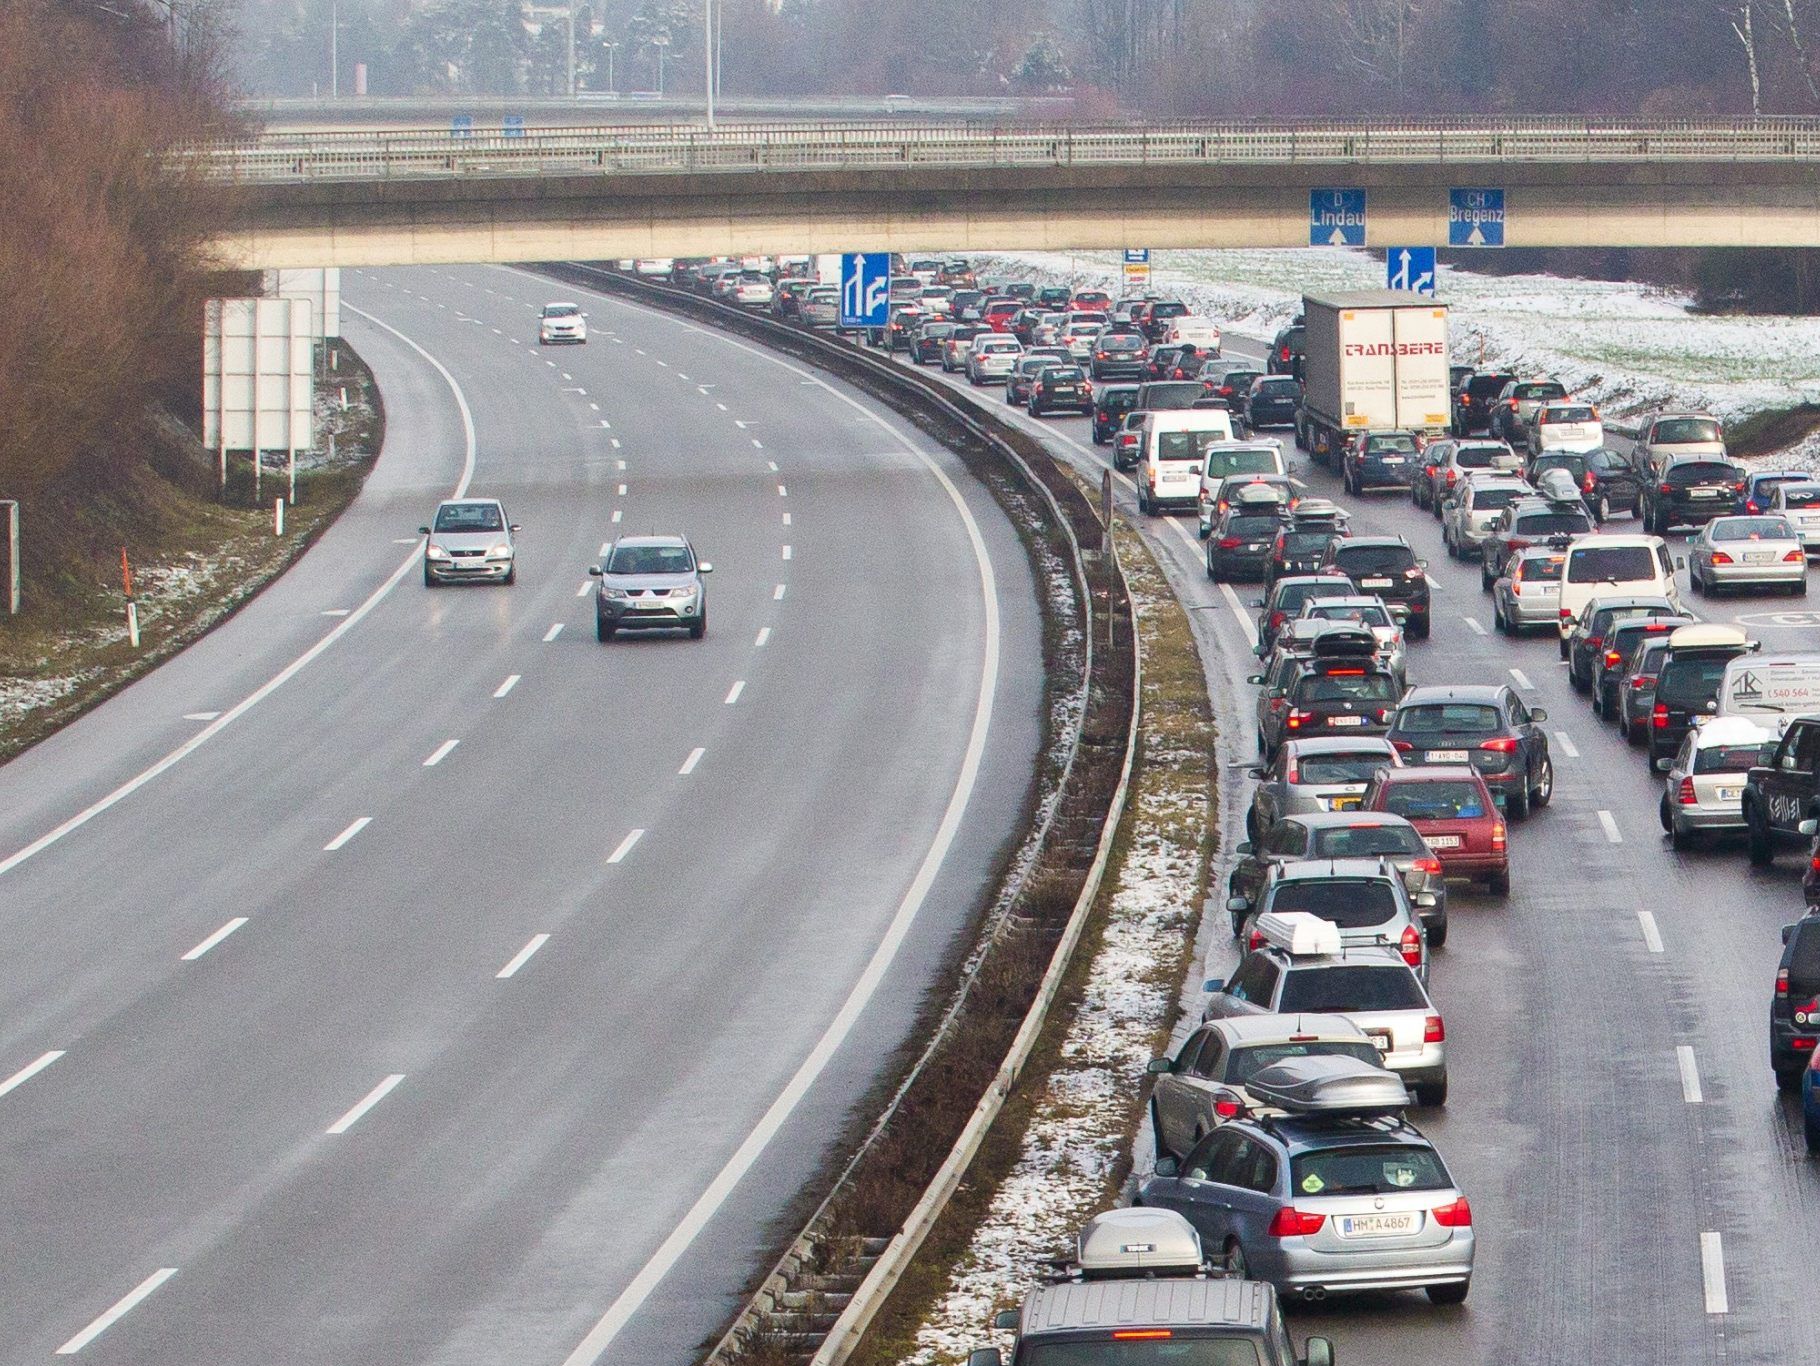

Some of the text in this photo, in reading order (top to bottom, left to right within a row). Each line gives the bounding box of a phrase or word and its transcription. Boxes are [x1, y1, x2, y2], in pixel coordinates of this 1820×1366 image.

[1311, 209, 1365, 226] Lindau
[1450, 205, 1504, 226] Bregenz
[1354, 1220, 1367, 1230] HM
[1385, 1217, 1410, 1229] 4867
